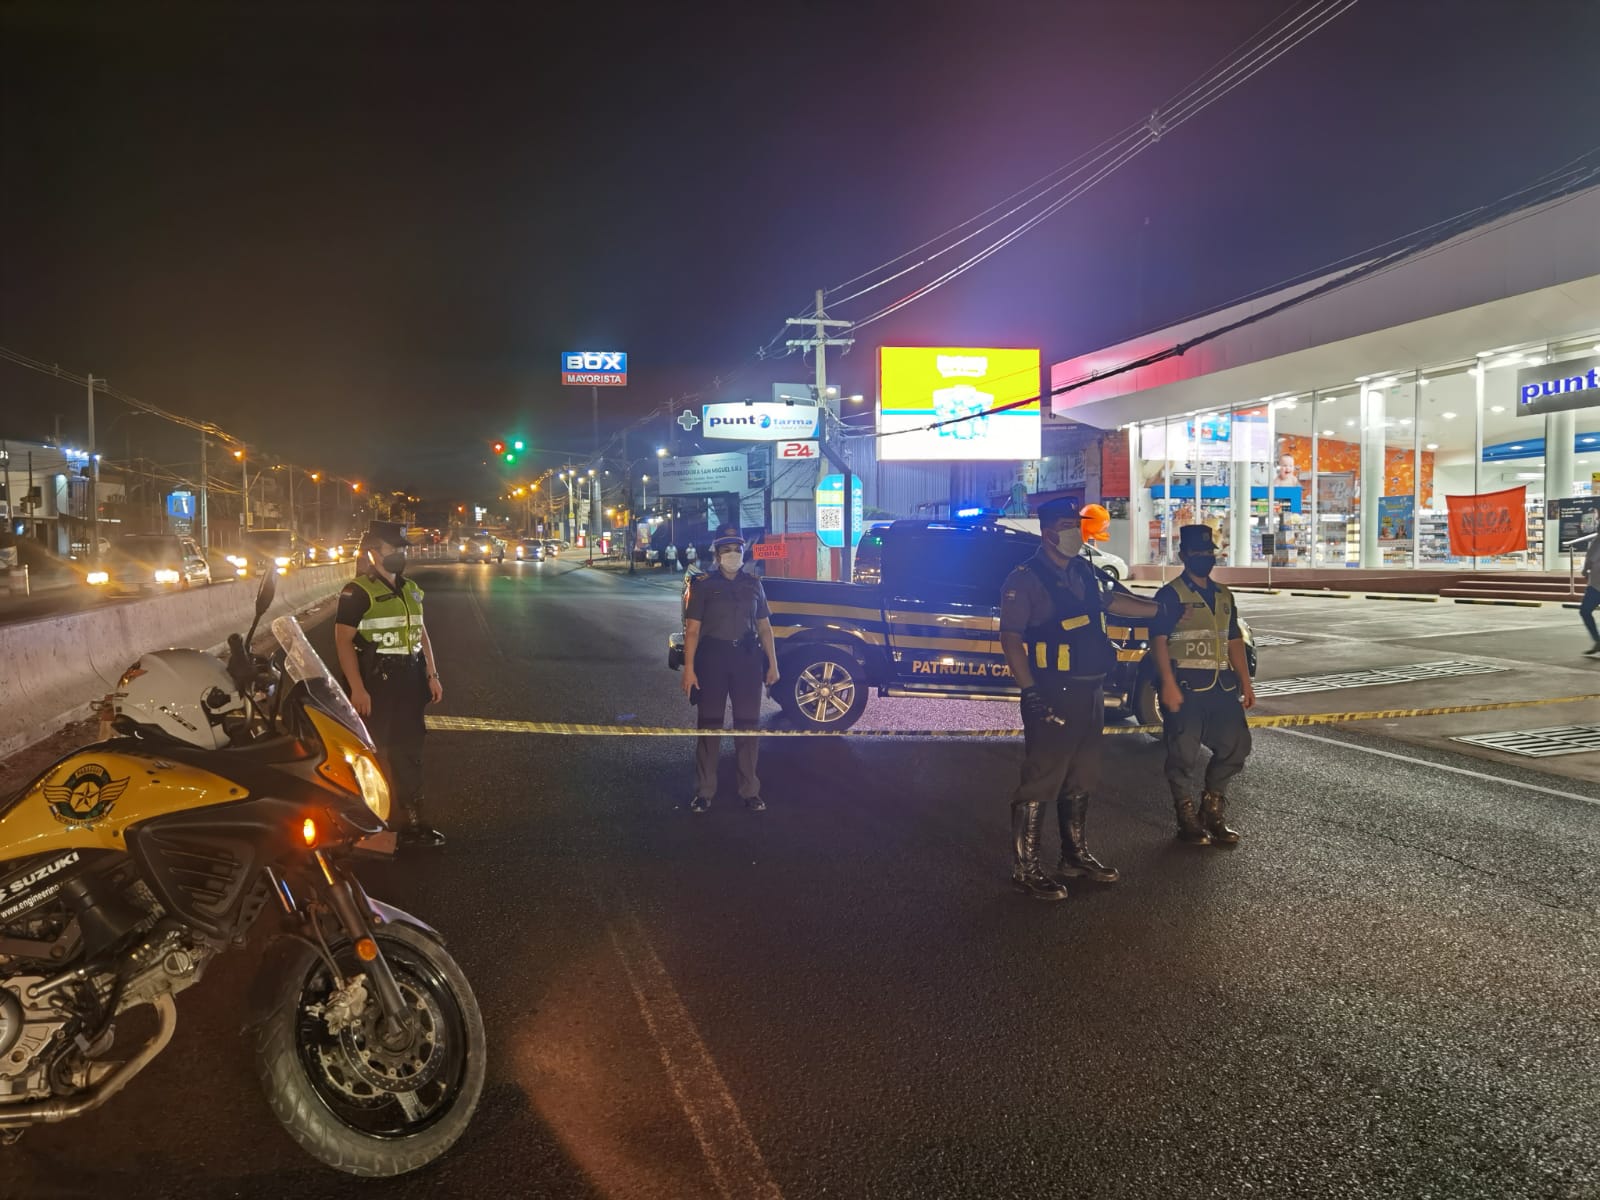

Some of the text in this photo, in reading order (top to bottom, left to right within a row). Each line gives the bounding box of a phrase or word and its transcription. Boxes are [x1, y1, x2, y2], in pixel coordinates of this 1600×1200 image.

[567, 353, 622, 370] BOX
[567, 374, 622, 383] MAYORISTA
[784, 443, 814, 457] 24
[1461, 509, 1511, 528] MEGA
[9, 851, 80, 893] SUZUKI
